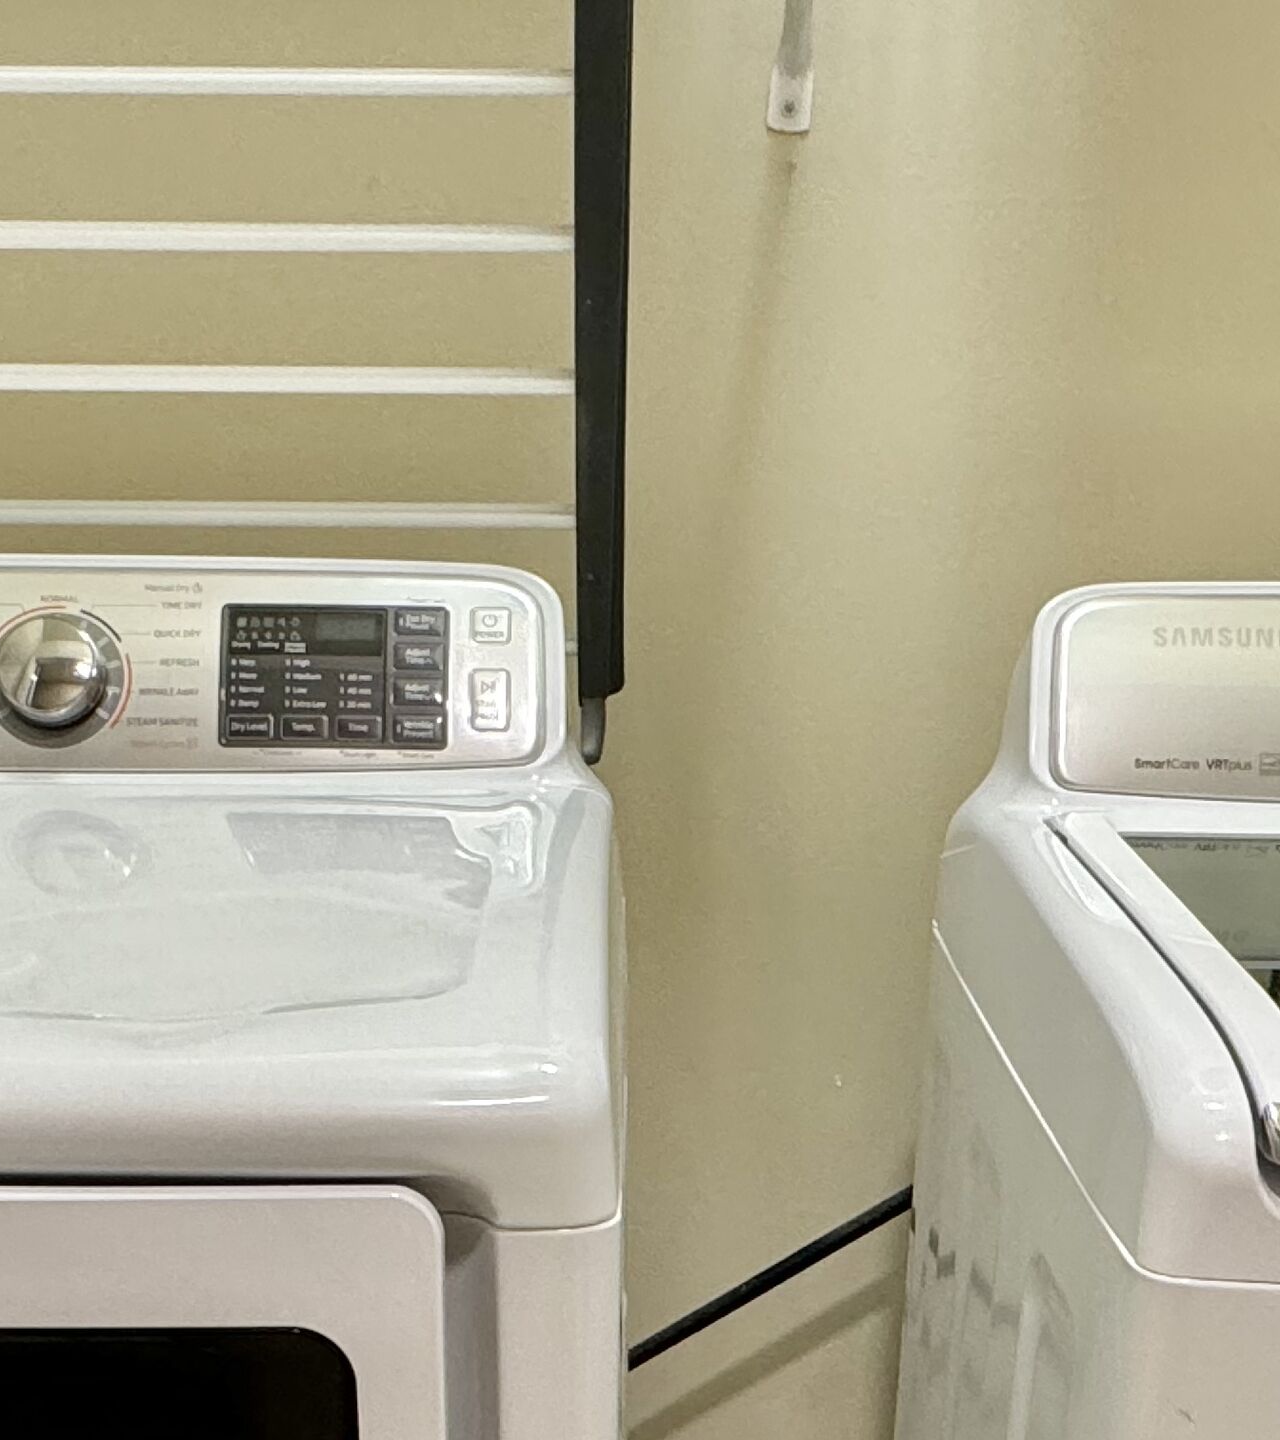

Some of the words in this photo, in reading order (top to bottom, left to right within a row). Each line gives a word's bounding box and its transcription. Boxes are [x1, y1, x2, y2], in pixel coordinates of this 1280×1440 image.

[40, 594, 78, 602] NORMAL
[154, 629, 180, 638] QUICK
[183, 629, 201, 638] DRY
[159, 658, 200, 667] REFRESH
[139, 688, 175, 696] WRINKLE
[126, 717, 157, 727] STEAM
[159, 718, 199, 727] SANITIZE
[230, 721, 247, 733] Dry
[1134, 758, 1200, 770] SmartCare
[1206, 758, 1253, 773] VRTplus
